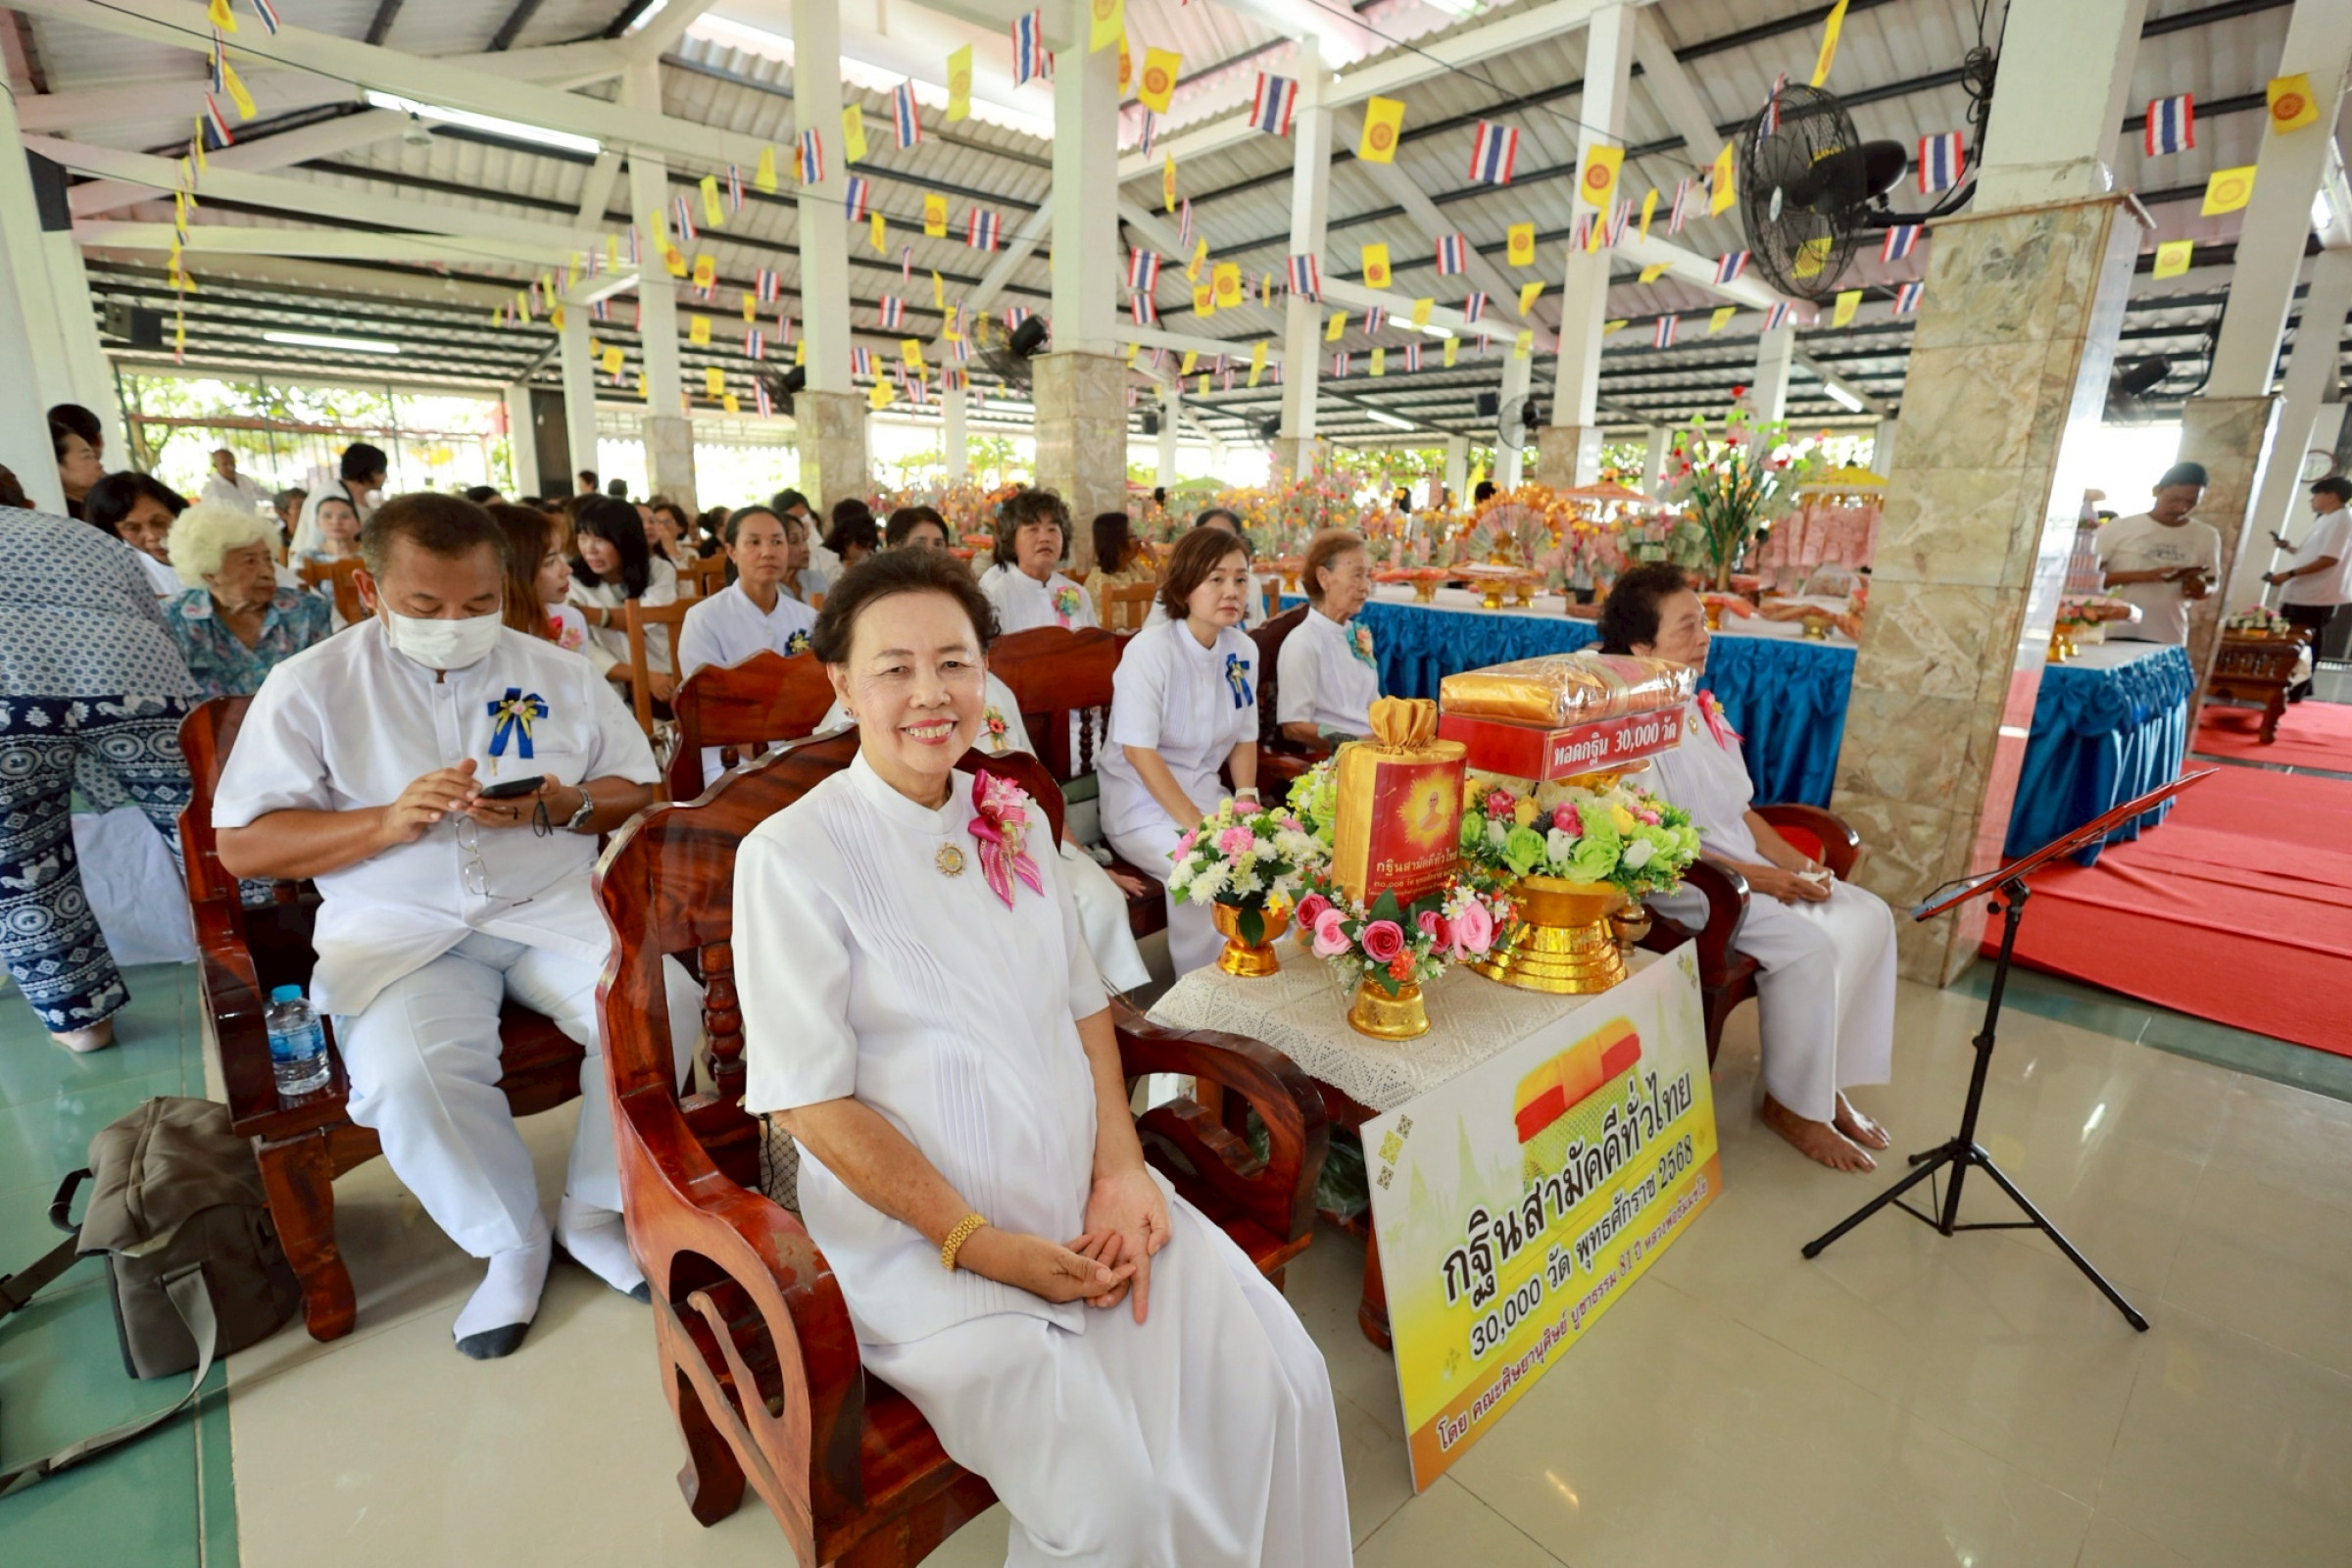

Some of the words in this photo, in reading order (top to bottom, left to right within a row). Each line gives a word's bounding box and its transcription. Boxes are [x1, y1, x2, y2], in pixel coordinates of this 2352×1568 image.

[1554, 732, 1609, 766] ทอดกฐิน
[1614, 722, 1659, 754] 30,000
[1661, 715, 1677, 741] วัด
[1443, 1071, 1692, 1307] กฐินสามัคคีทั่วไทย
[1472, 1278, 1542, 1355] 30,000
[1546, 1248, 1571, 1288] วัด
[1576, 1174, 1656, 1269] พุทธศักราช
[1658, 1134, 1693, 1190] 2568
[1438, 1414, 1467, 1449] โดย
[1473, 1309, 1568, 1421] คณะศิษยานุศิษย์
[1571, 1271, 1617, 1330] บูชาธรรม
[1620, 1250, 1633, 1277] 81
